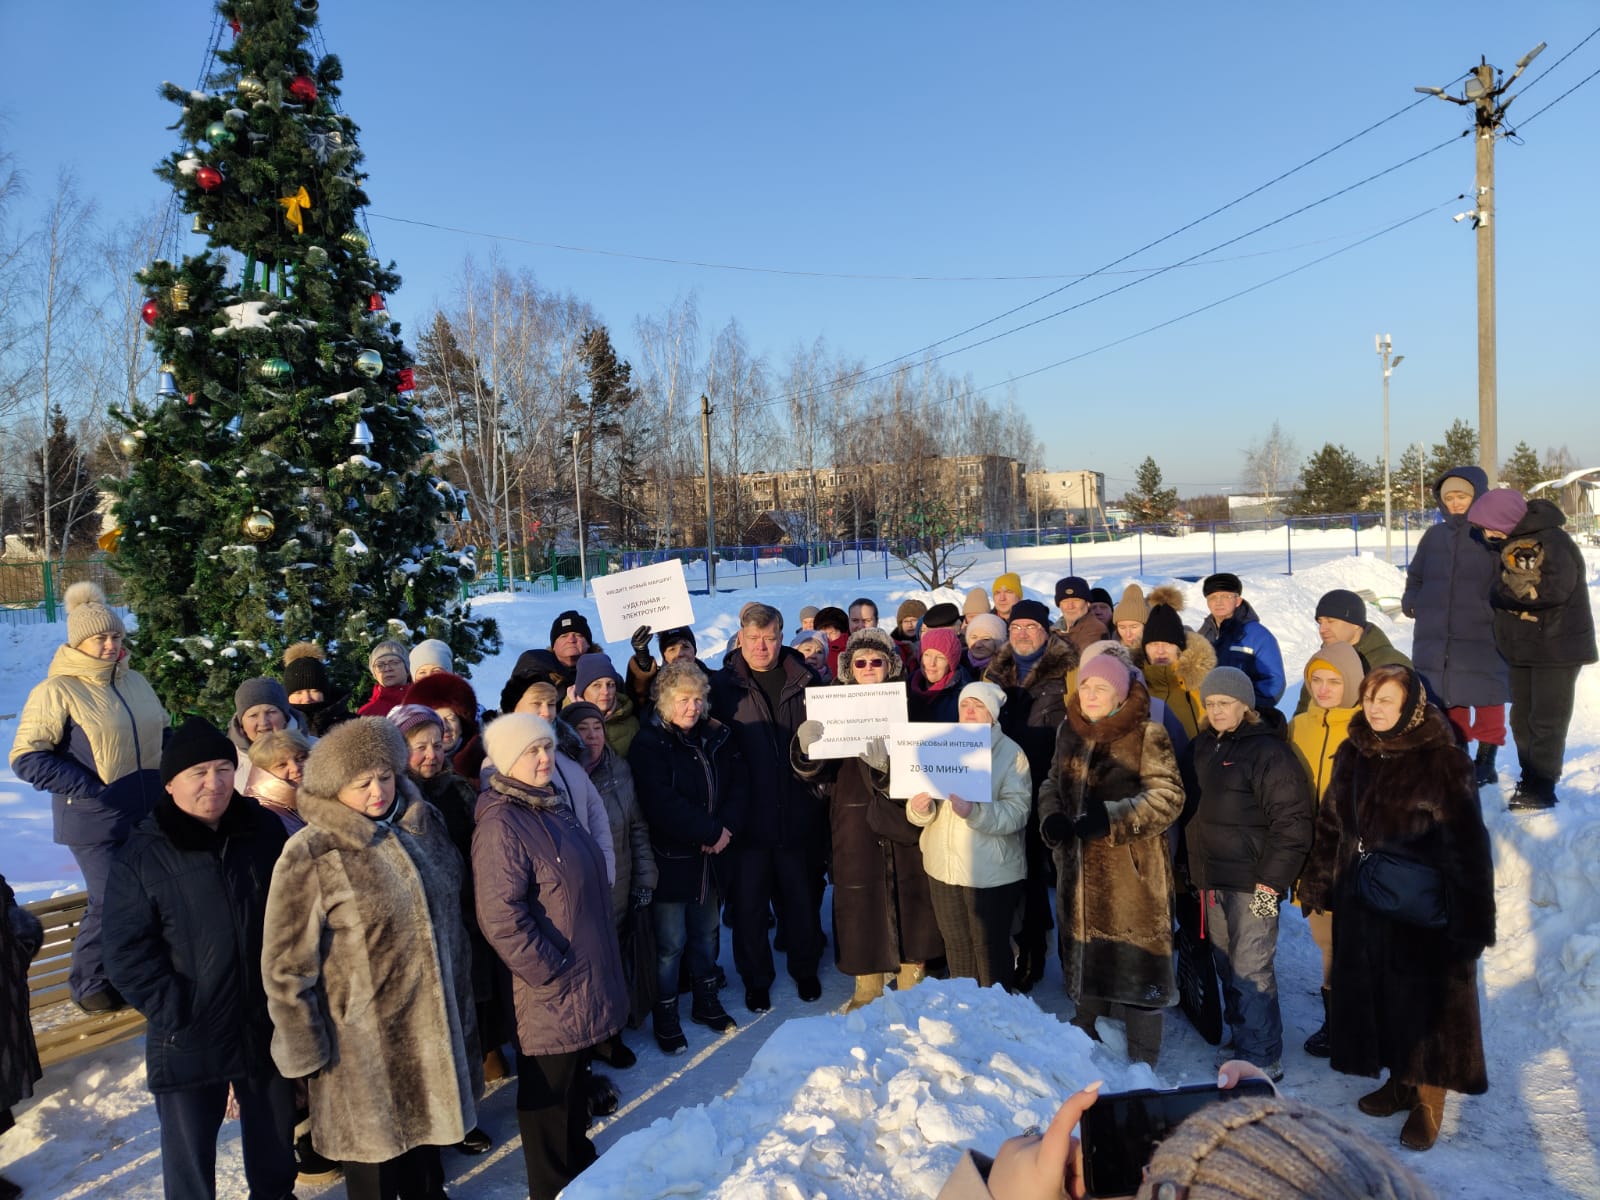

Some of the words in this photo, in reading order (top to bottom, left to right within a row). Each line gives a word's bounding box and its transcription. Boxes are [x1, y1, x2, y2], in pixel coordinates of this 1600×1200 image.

[897, 739, 948, 747] МЕЖРЕЙСОВЫЙ
[949, 740, 984, 748] ИНТЕРВАЛ
[910, 764, 934, 773] 20-30
[935, 765, 970, 774] МИНУТ
